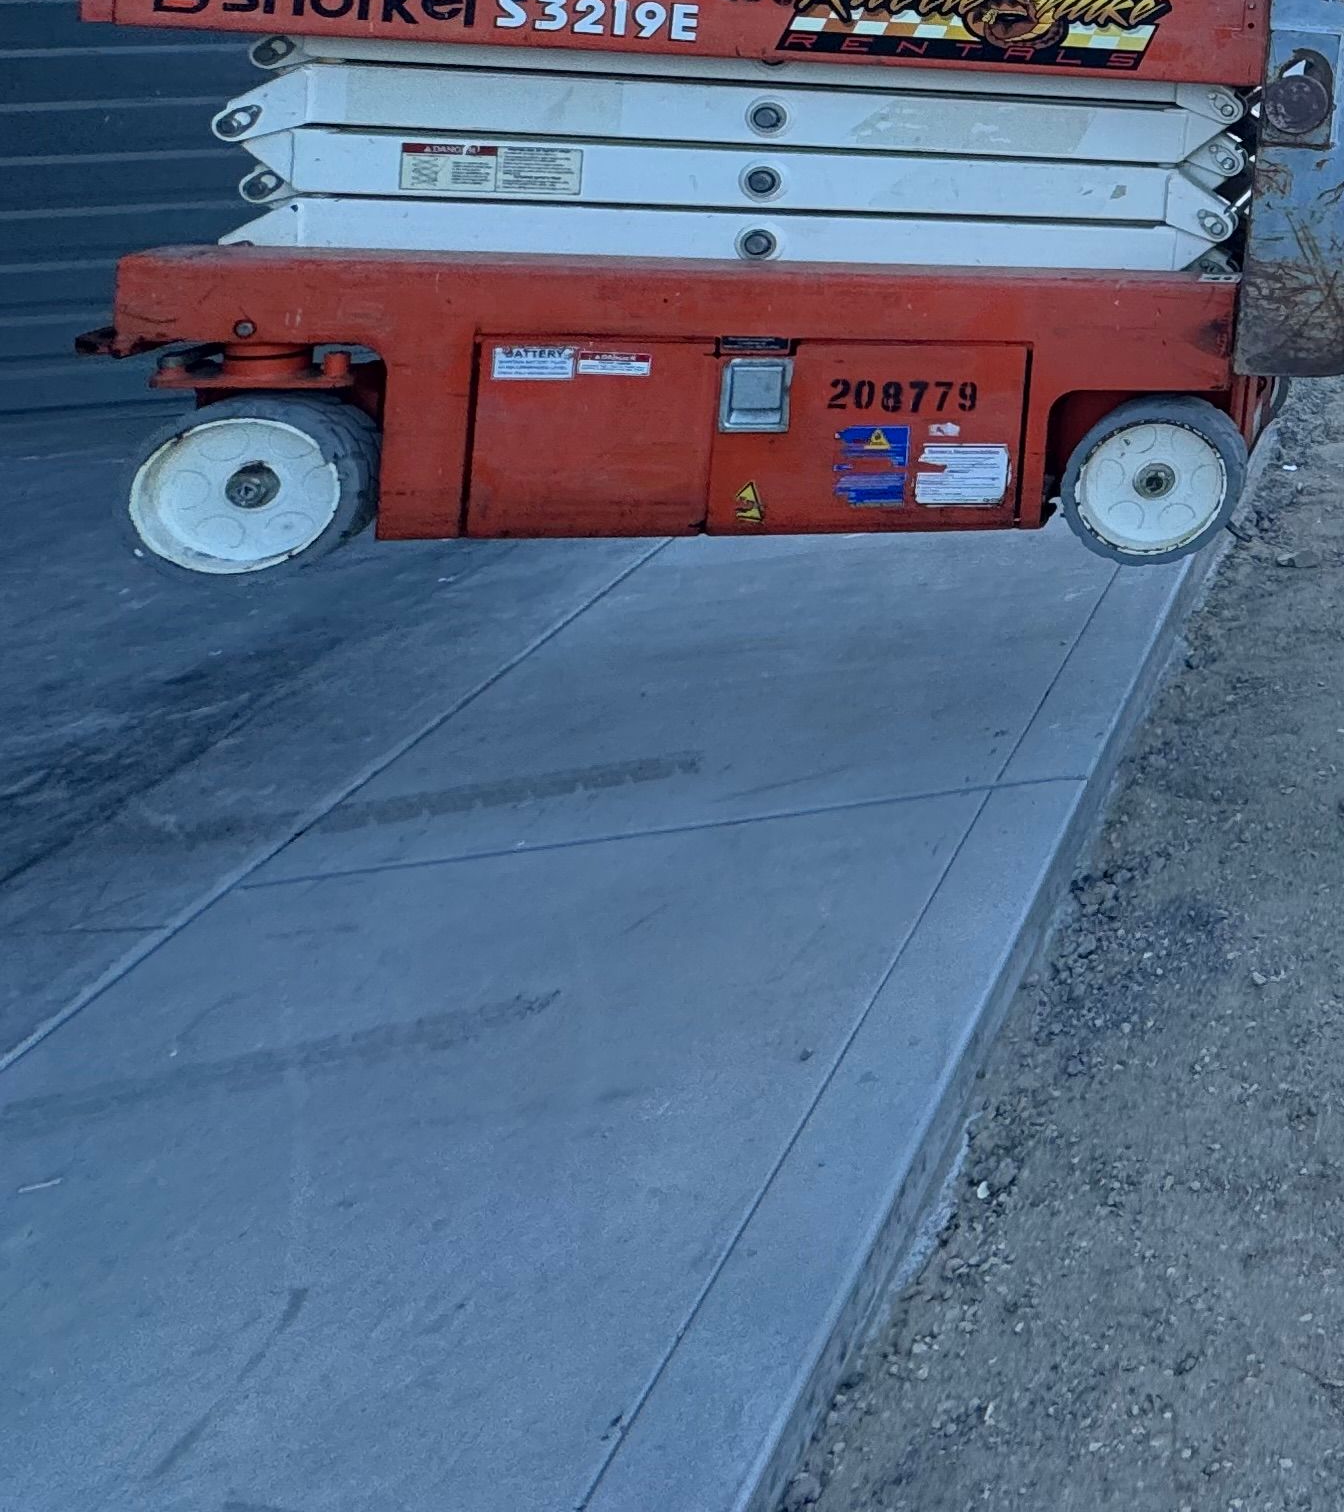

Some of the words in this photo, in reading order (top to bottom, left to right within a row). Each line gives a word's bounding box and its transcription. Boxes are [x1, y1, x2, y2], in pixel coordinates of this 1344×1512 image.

[783, 33, 1140, 67] RENTALS
[433, 145, 477, 154] DANG
[827, 379, 978, 413] 208779
